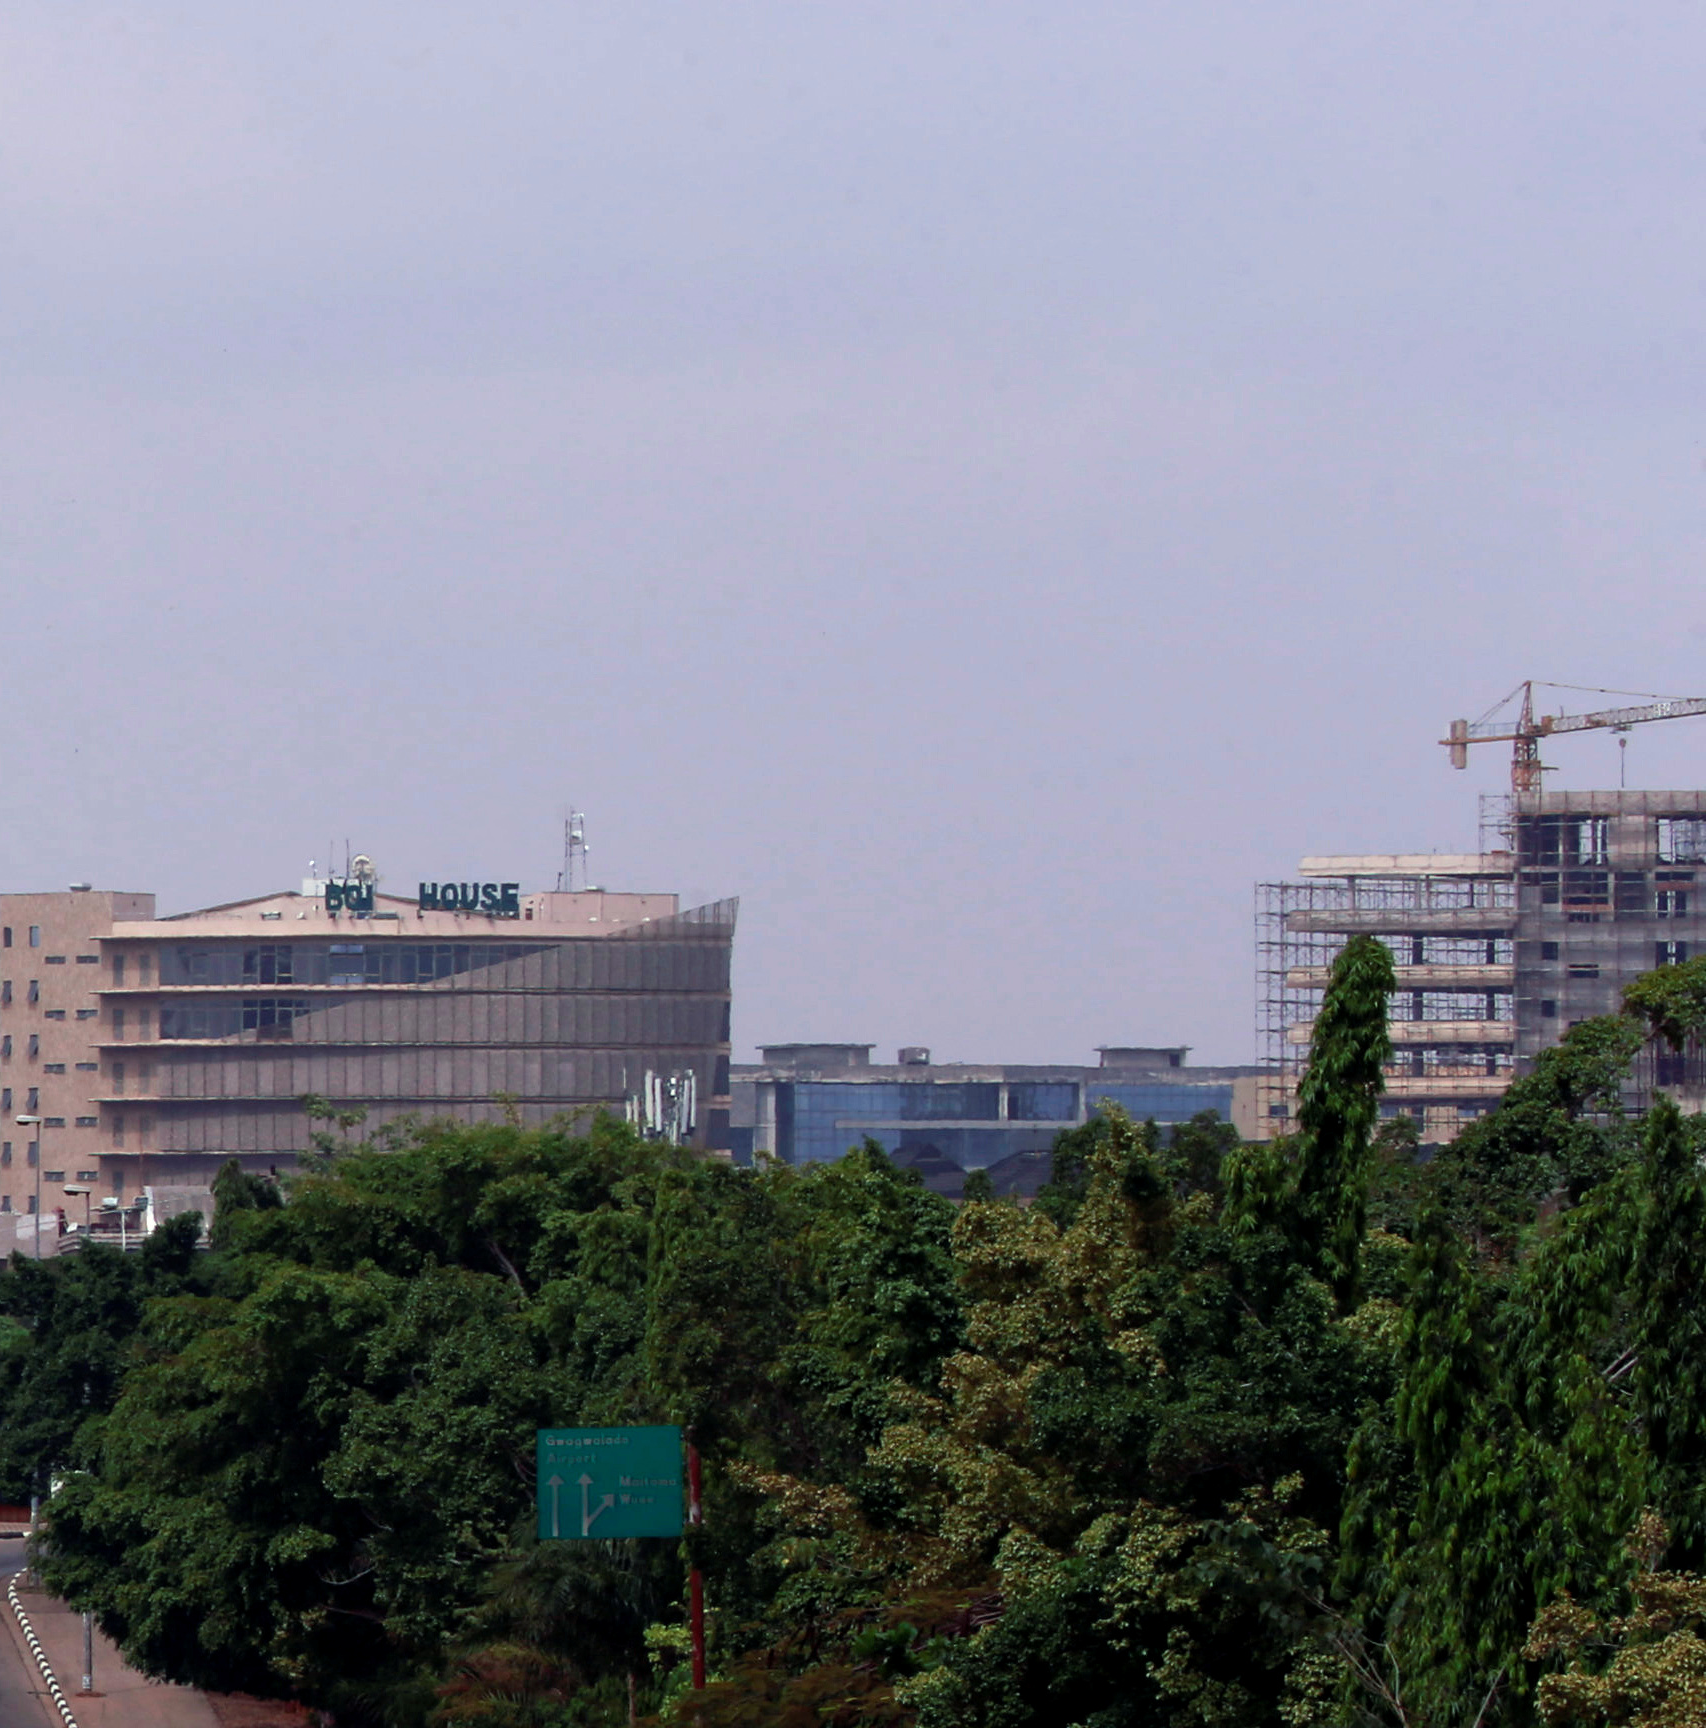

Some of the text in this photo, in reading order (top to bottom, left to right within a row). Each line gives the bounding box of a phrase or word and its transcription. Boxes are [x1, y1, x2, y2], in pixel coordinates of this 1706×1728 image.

[419, 882, 520, 912] HOUSE
[547, 1452, 596, 1466] Airport
[620, 1475, 677, 1487] Maitama
